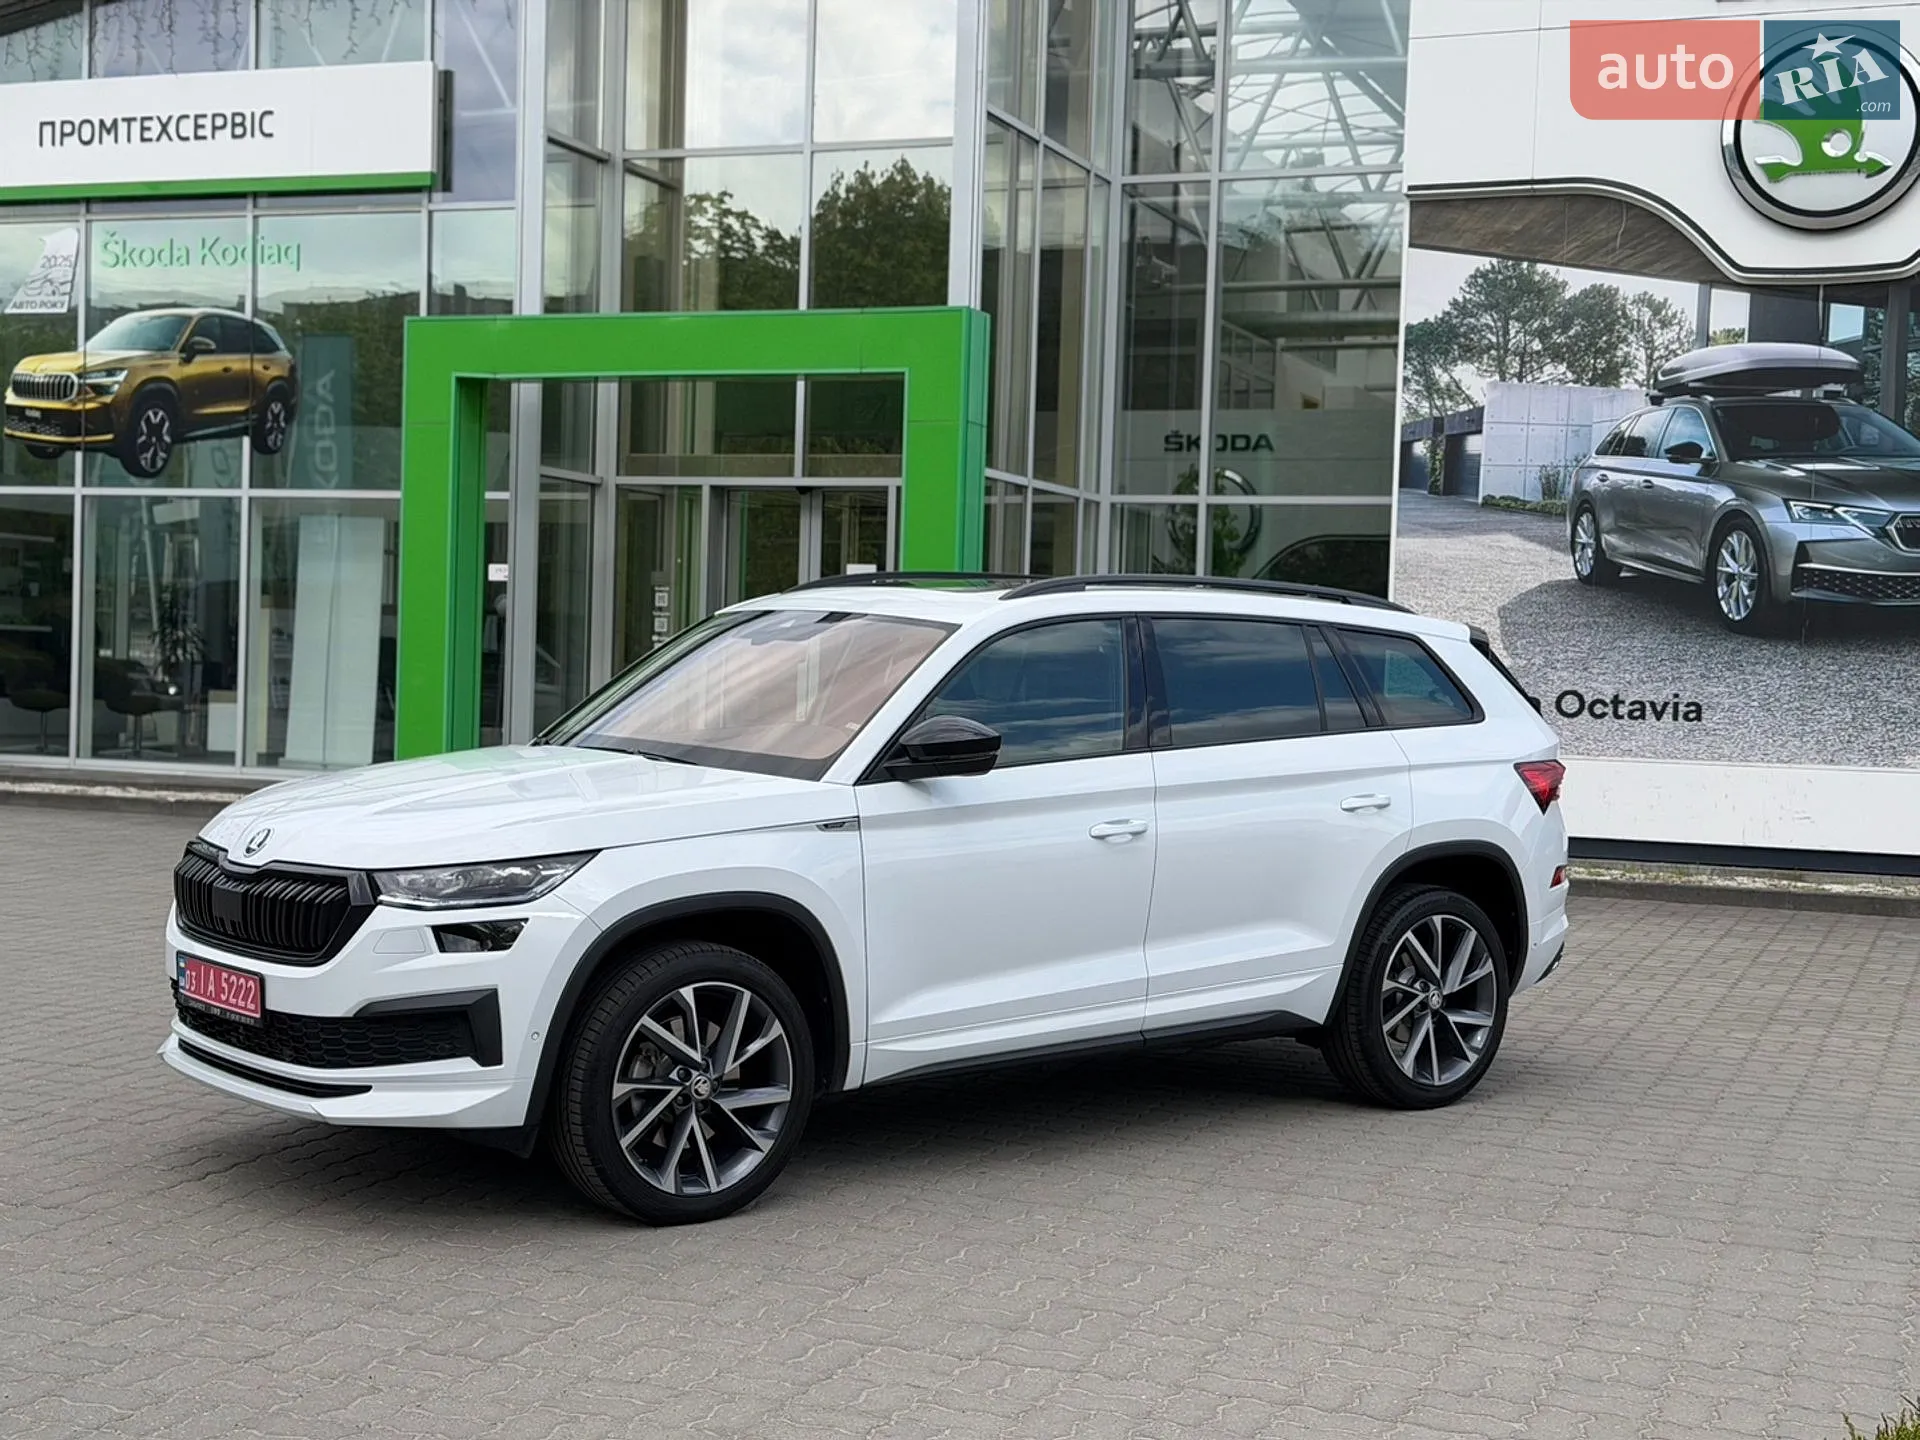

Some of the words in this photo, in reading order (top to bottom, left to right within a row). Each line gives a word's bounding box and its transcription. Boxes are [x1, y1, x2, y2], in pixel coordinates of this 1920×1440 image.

[38, 110, 275, 148] ПРОМТЕХСЕРВІС
[41, 254, 74, 269] 2025
[100, 230, 191, 269] Škoda
[1163, 429, 1275, 453] ŠKODA
[1554, 689, 1703, 722] Octavia
[220, 971, 256, 1010] 5222
